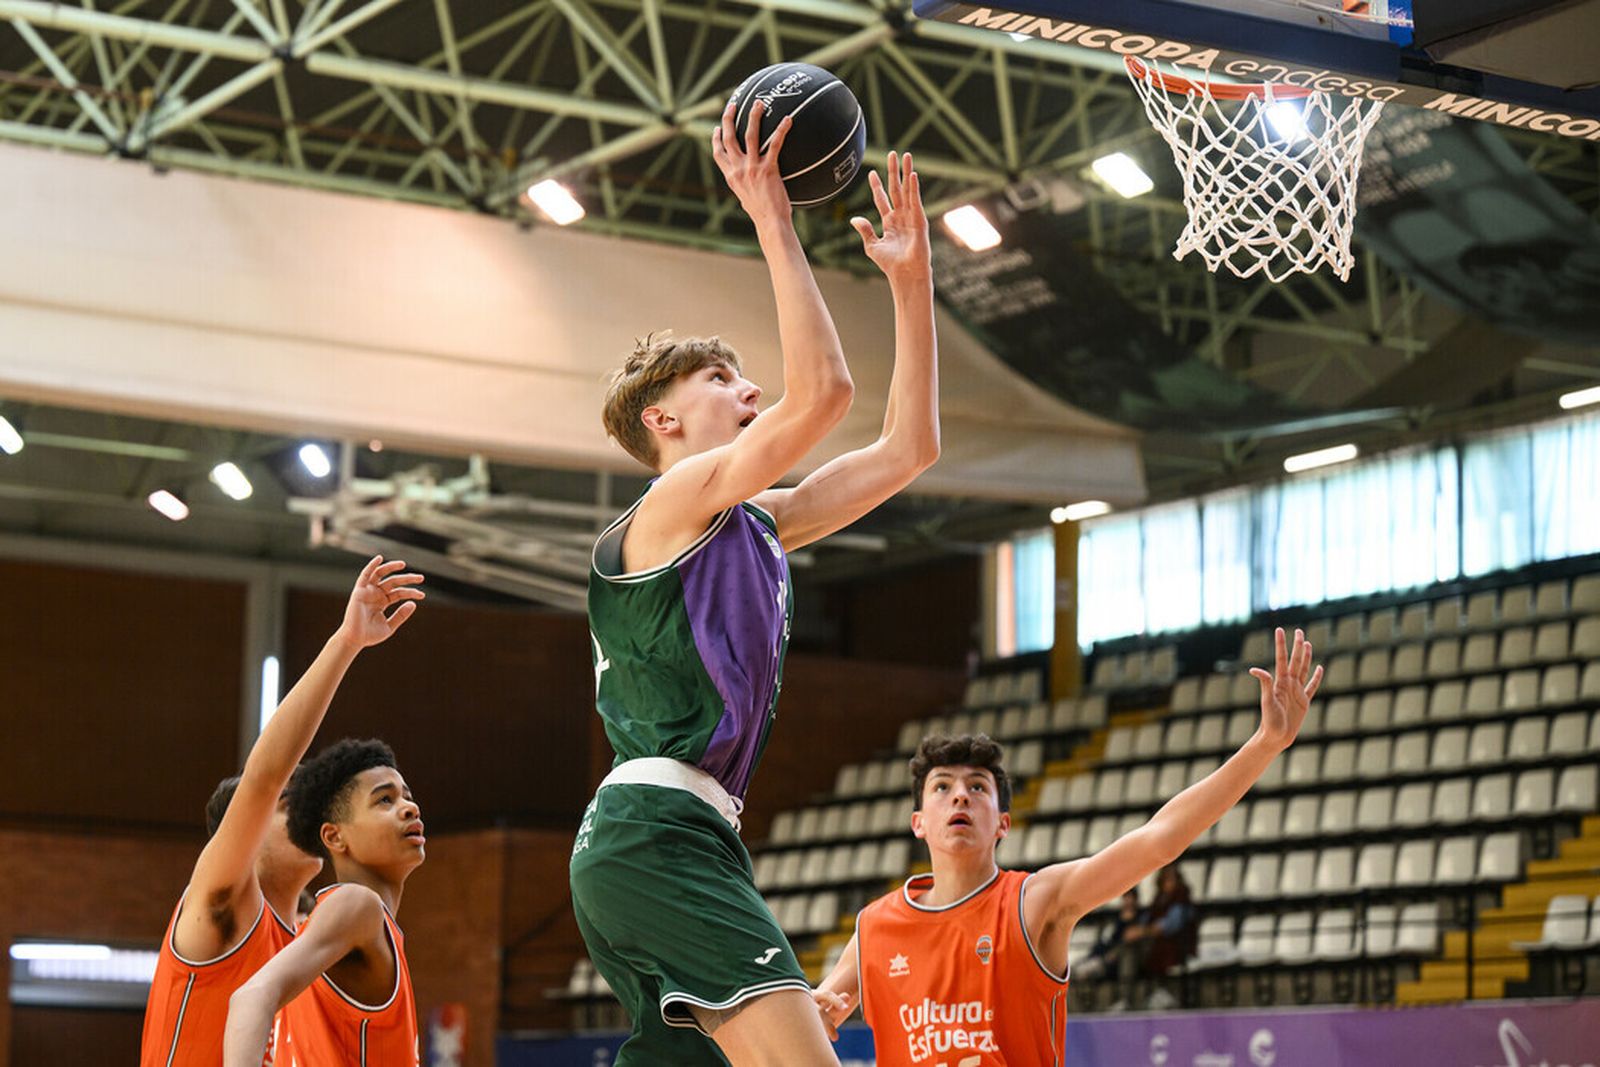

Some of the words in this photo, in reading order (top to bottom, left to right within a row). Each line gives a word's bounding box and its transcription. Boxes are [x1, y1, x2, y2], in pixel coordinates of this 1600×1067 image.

[958, 7, 1220, 69] MINICOPA
[1224, 60, 1406, 102] endesa
[899, 997, 982, 1032] Cultura
